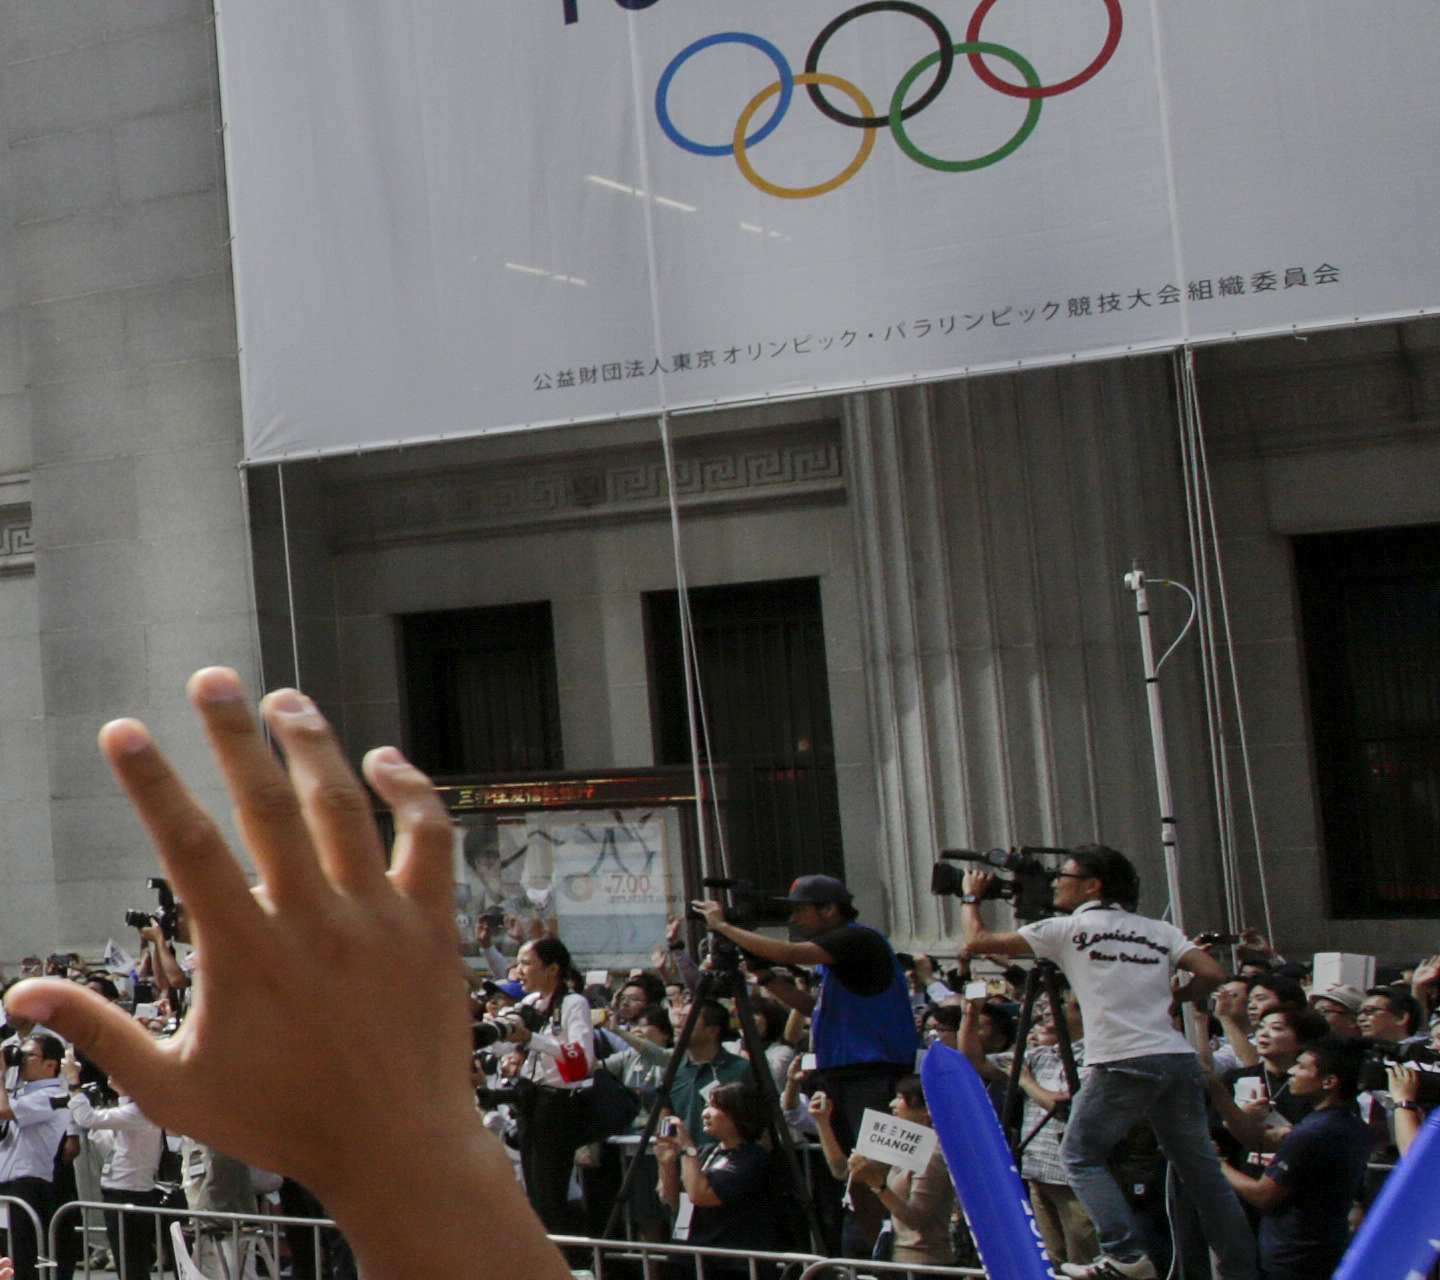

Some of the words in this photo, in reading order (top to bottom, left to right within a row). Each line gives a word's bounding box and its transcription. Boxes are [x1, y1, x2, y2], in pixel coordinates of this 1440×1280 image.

[533, 262, 1341, 391] 公益財団法人東京オリンピック・パラリンピック競技大会組織委員会
[1072, 930, 1171, 955] Louisiana
[869, 1133, 917, 1155] CHANGE
[873, 1121, 888, 1133] BE
[899, 1129, 923, 1145] THE
